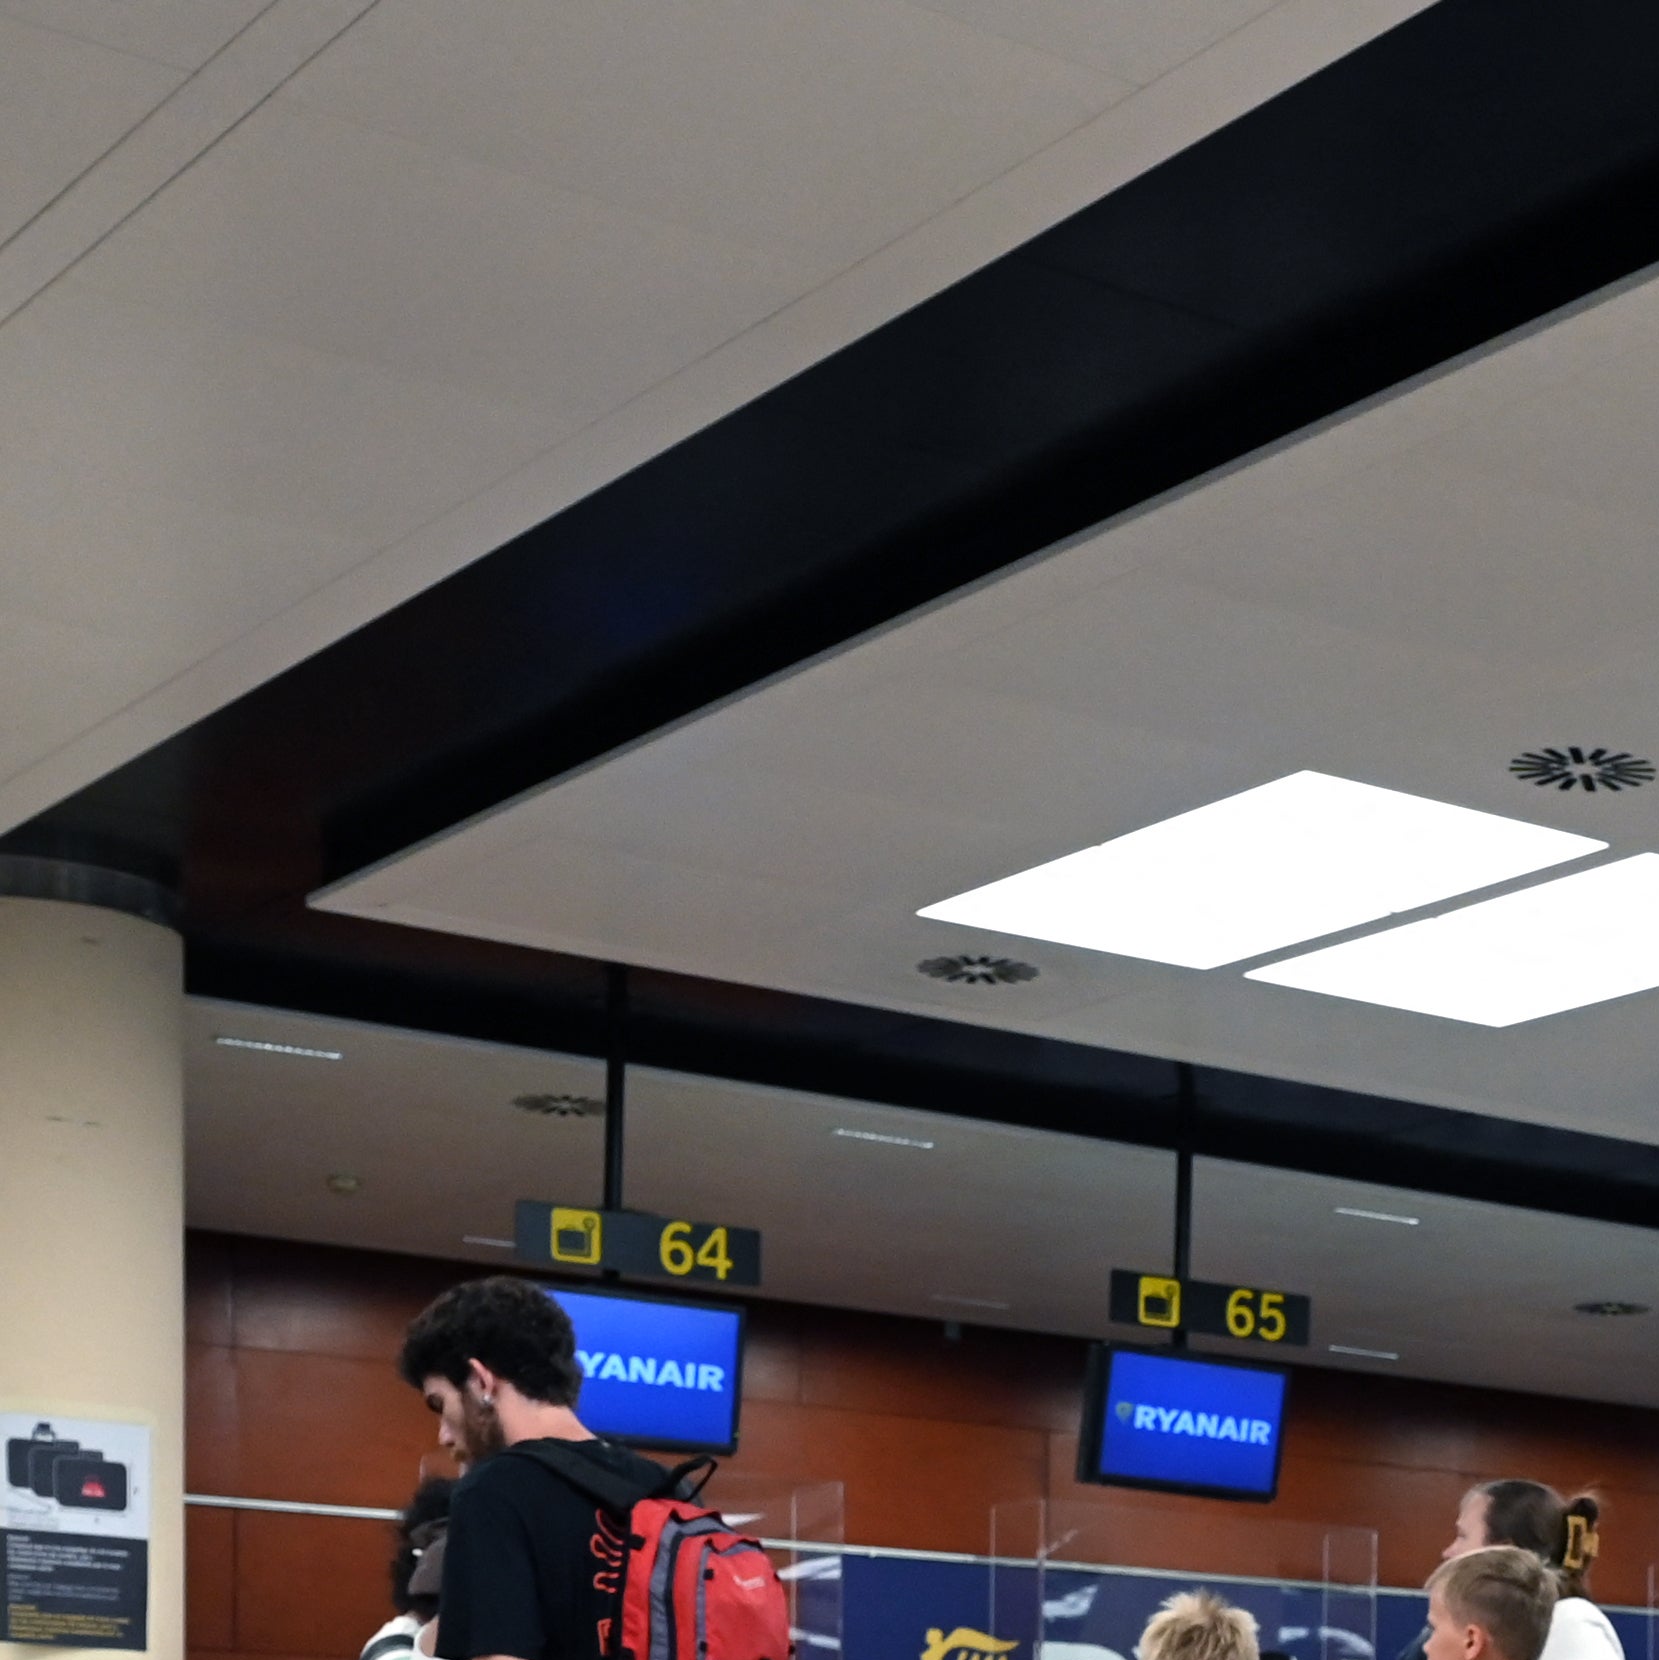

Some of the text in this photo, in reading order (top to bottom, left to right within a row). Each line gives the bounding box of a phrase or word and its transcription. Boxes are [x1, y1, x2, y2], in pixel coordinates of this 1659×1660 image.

[659, 1220, 734, 1280] 64
[1226, 1288, 1287, 1342] 65
[573, 1349, 726, 1393] YANAIR
[1132, 1403, 1273, 1446] RYANAIR
